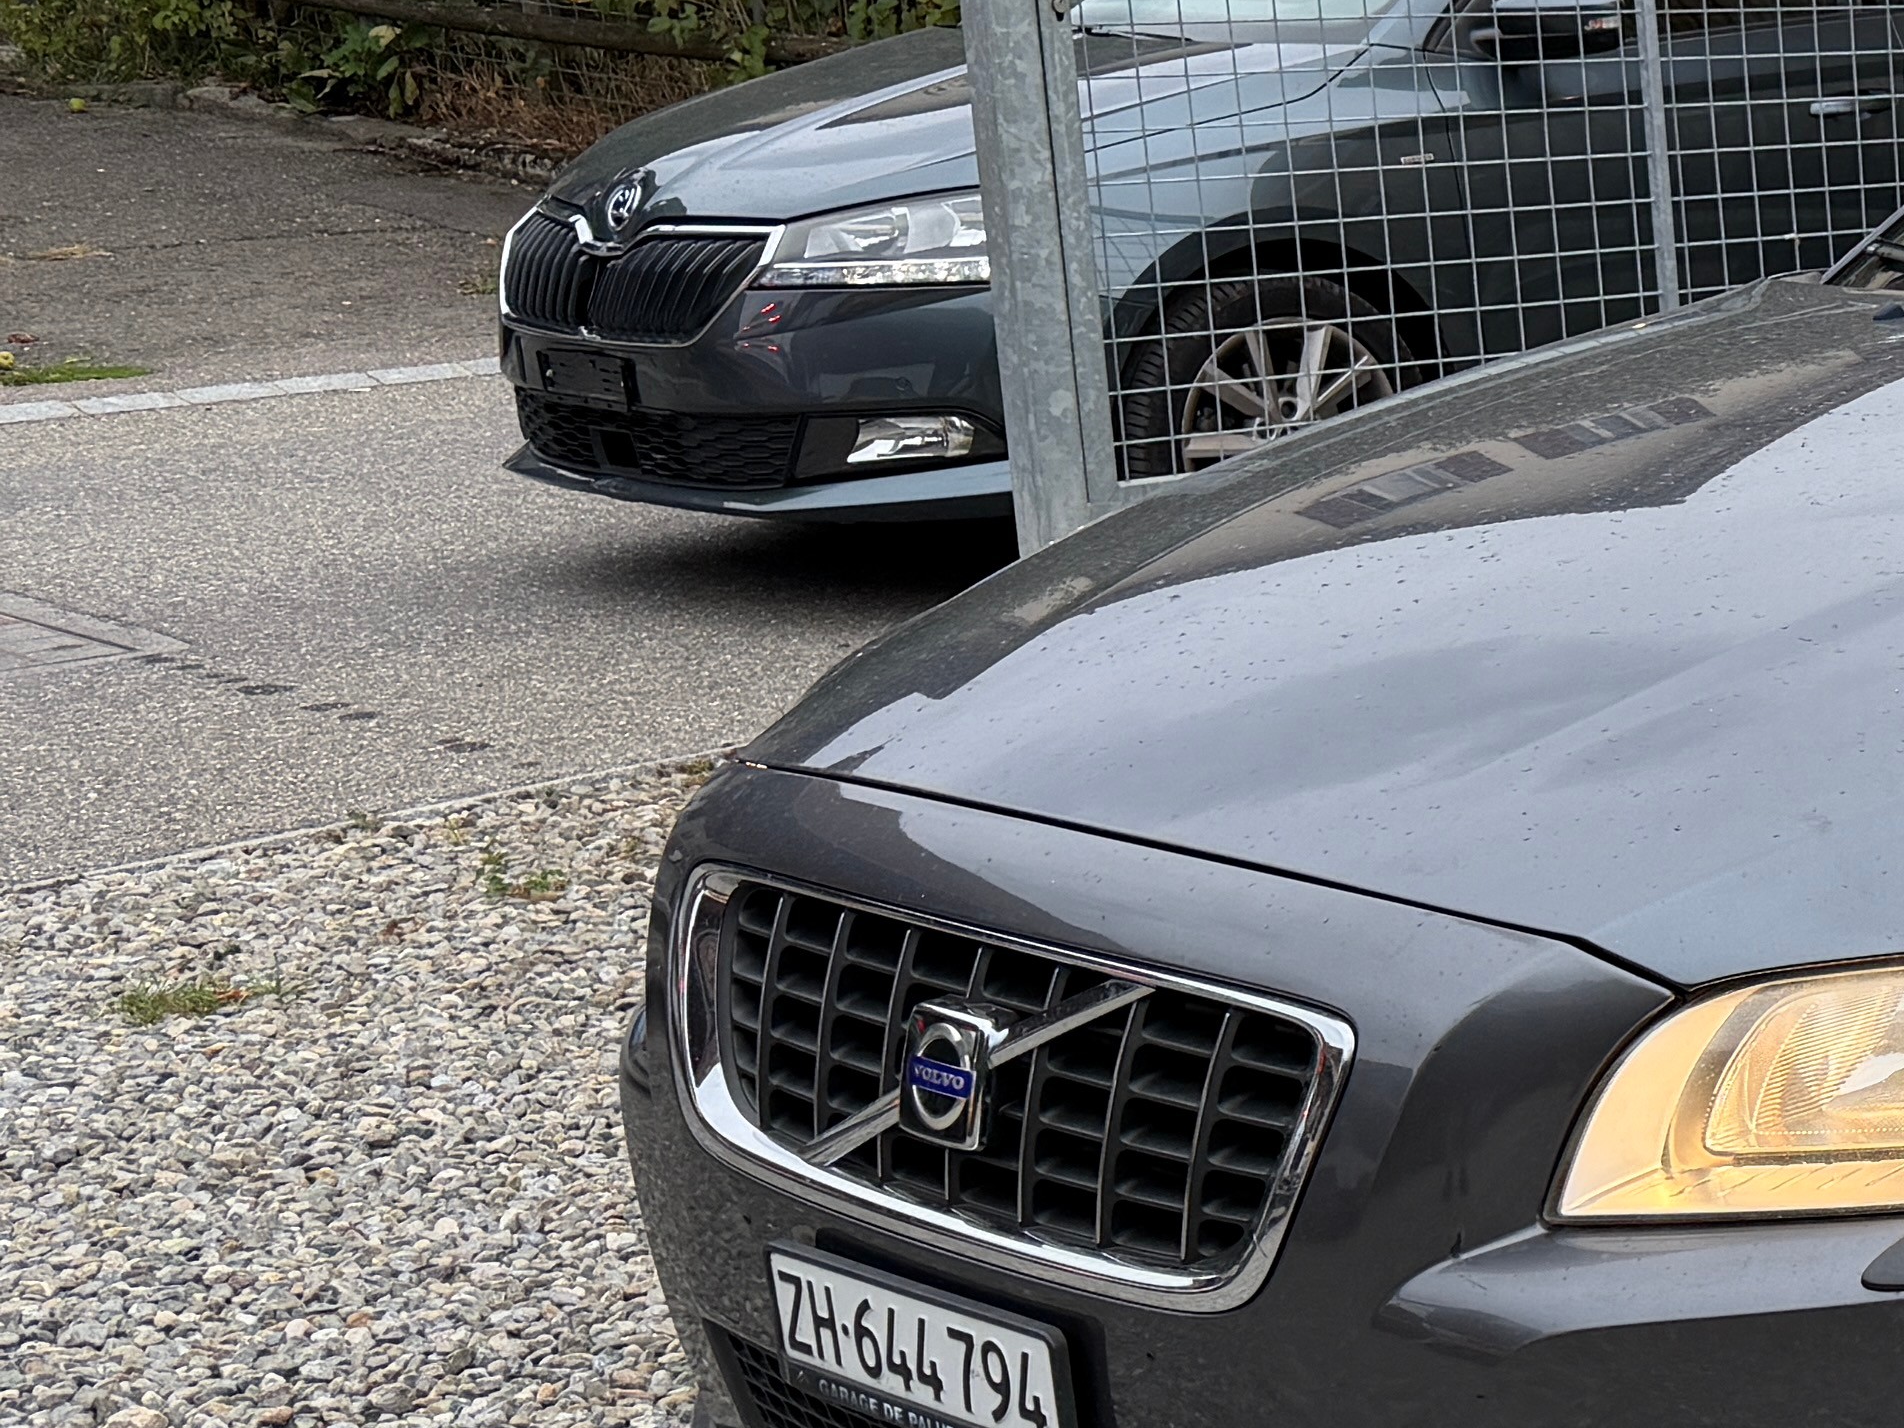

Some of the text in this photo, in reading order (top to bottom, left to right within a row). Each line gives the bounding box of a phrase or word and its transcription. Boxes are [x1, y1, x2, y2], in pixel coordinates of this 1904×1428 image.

[914, 1063, 965, 1090] VOLVO
[818, 1378, 879, 1416] GARAGE
[884, 1401, 903, 1423] DE
